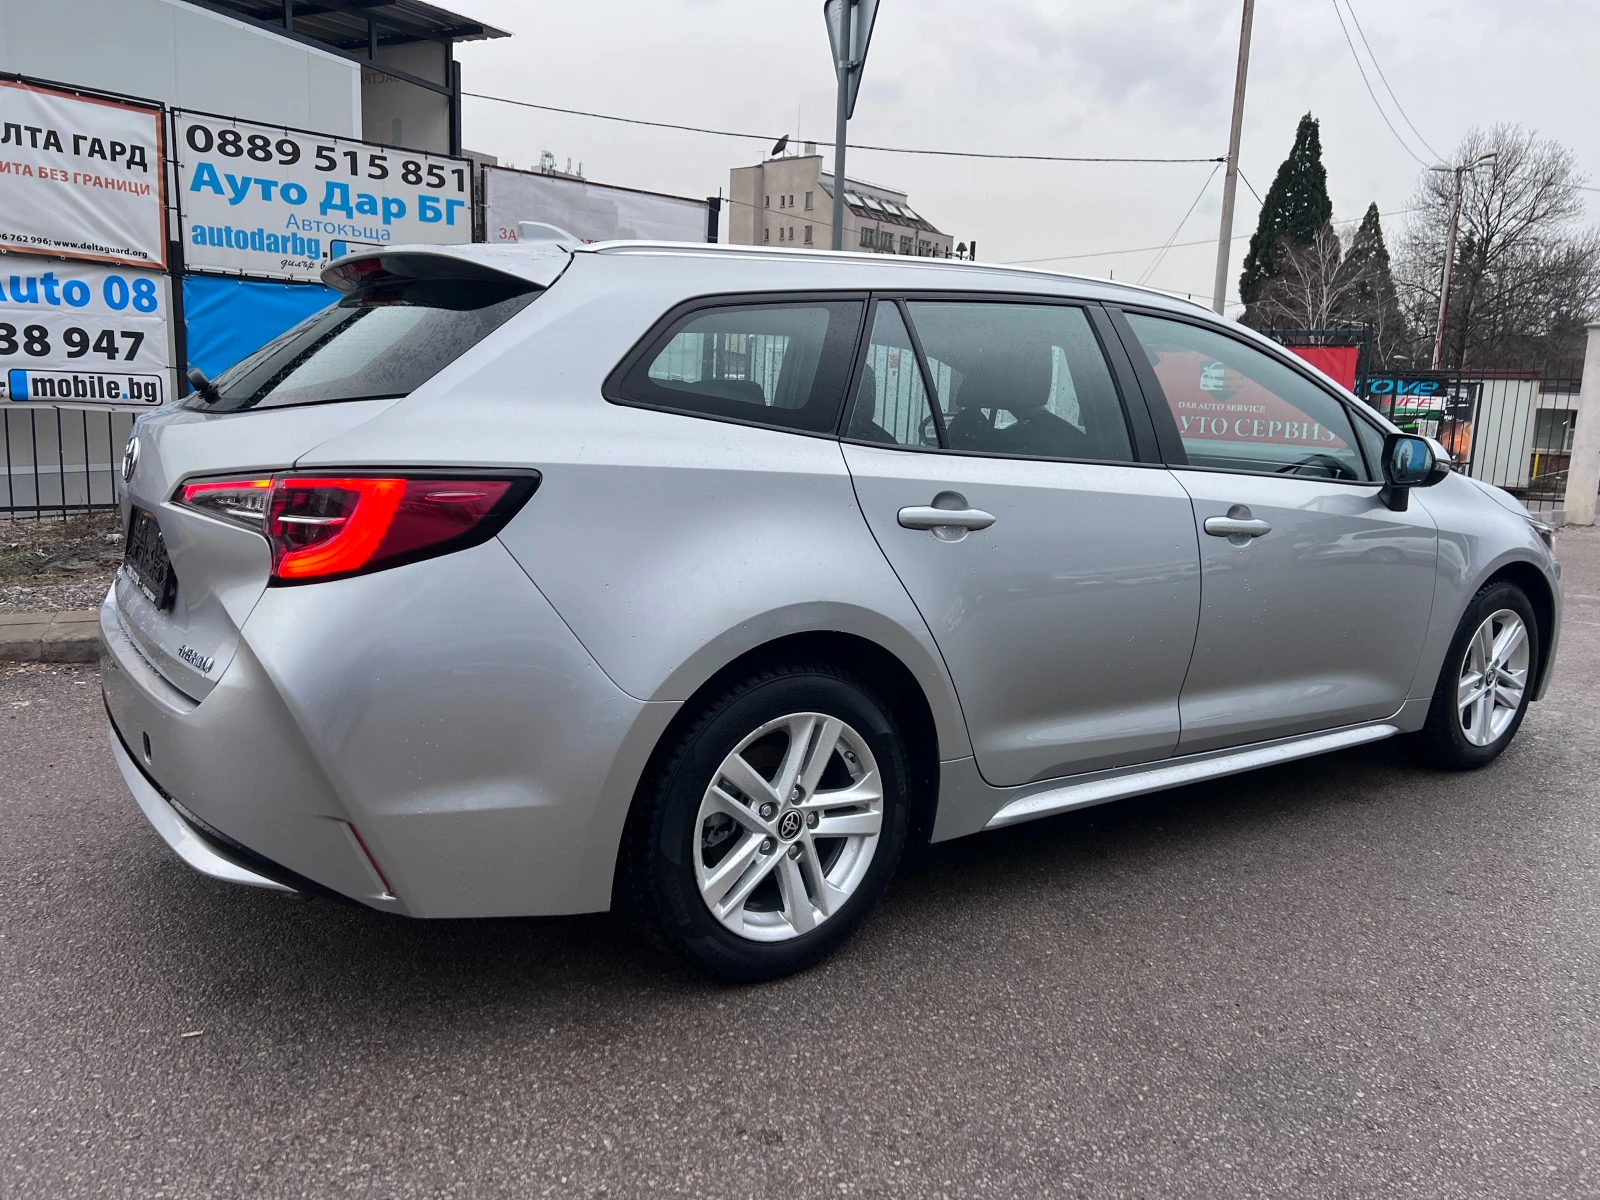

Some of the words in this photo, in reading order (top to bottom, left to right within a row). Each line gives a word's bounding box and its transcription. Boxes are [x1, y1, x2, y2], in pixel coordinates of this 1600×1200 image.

[1, 122, 64, 153] ЛТА
[73, 134, 148, 173] ГАРД
[186, 124, 301, 165] 0889
[314, 145, 389, 180] 515
[401, 160, 465, 192] 851
[38, 166, 69, 182] БЕЗ
[73, 172, 151, 196] ГРАНИЦИ
[189, 161, 308, 206] Ауто
[319, 180, 407, 225] Дар
[418, 194, 465, 226] БГ
[286, 213, 391, 242] Автокъща
[499, 227, 517, 241] ЗА
[10, 233, 28, 243] 762
[30, 236, 52, 246] 996;
[54, 239, 148, 259] www.deltaguard.org
[103, 275, 158, 313] 08
[62, 327, 145, 361] 947
[32, 375, 157, 403] mobile.bg
[1178, 401, 1198, 410] DAR
[1198, 403, 1224, 412] AUTO
[1226, 404, 1266, 413] SERVICE
